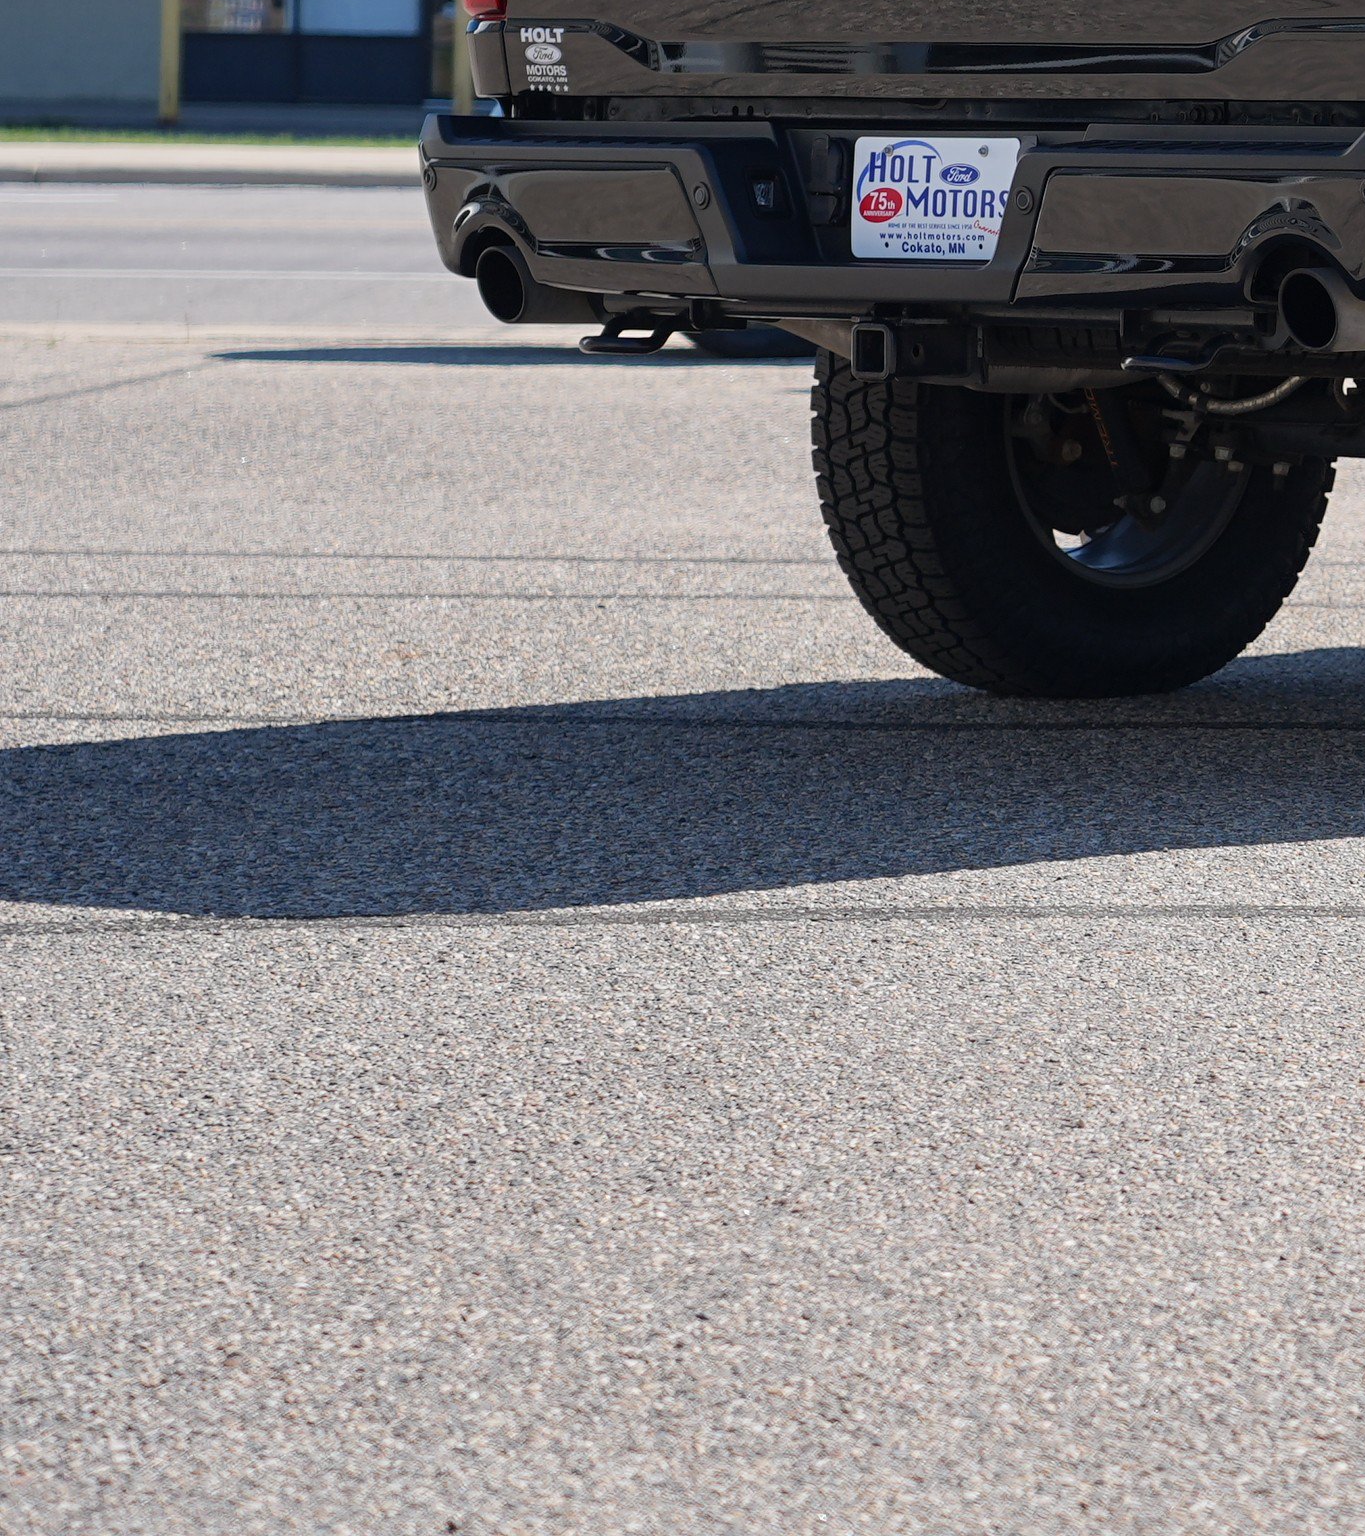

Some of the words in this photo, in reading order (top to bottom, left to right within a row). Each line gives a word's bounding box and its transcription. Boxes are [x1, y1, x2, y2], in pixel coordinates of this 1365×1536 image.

[520, 27, 565, 43] HOLT
[532, 46, 555, 61] Ford
[526, 64, 567, 76] MOTORS
[868, 151, 937, 184] HOLT
[946, 165, 973, 183] Ford
[869, 192, 896, 211] 75th
[905, 186, 1010, 219] MOTORS
[879, 231, 985, 241] www.holtmotors.com
[901, 241, 945, 256] Cokato,
[948, 242, 966, 254] MN
